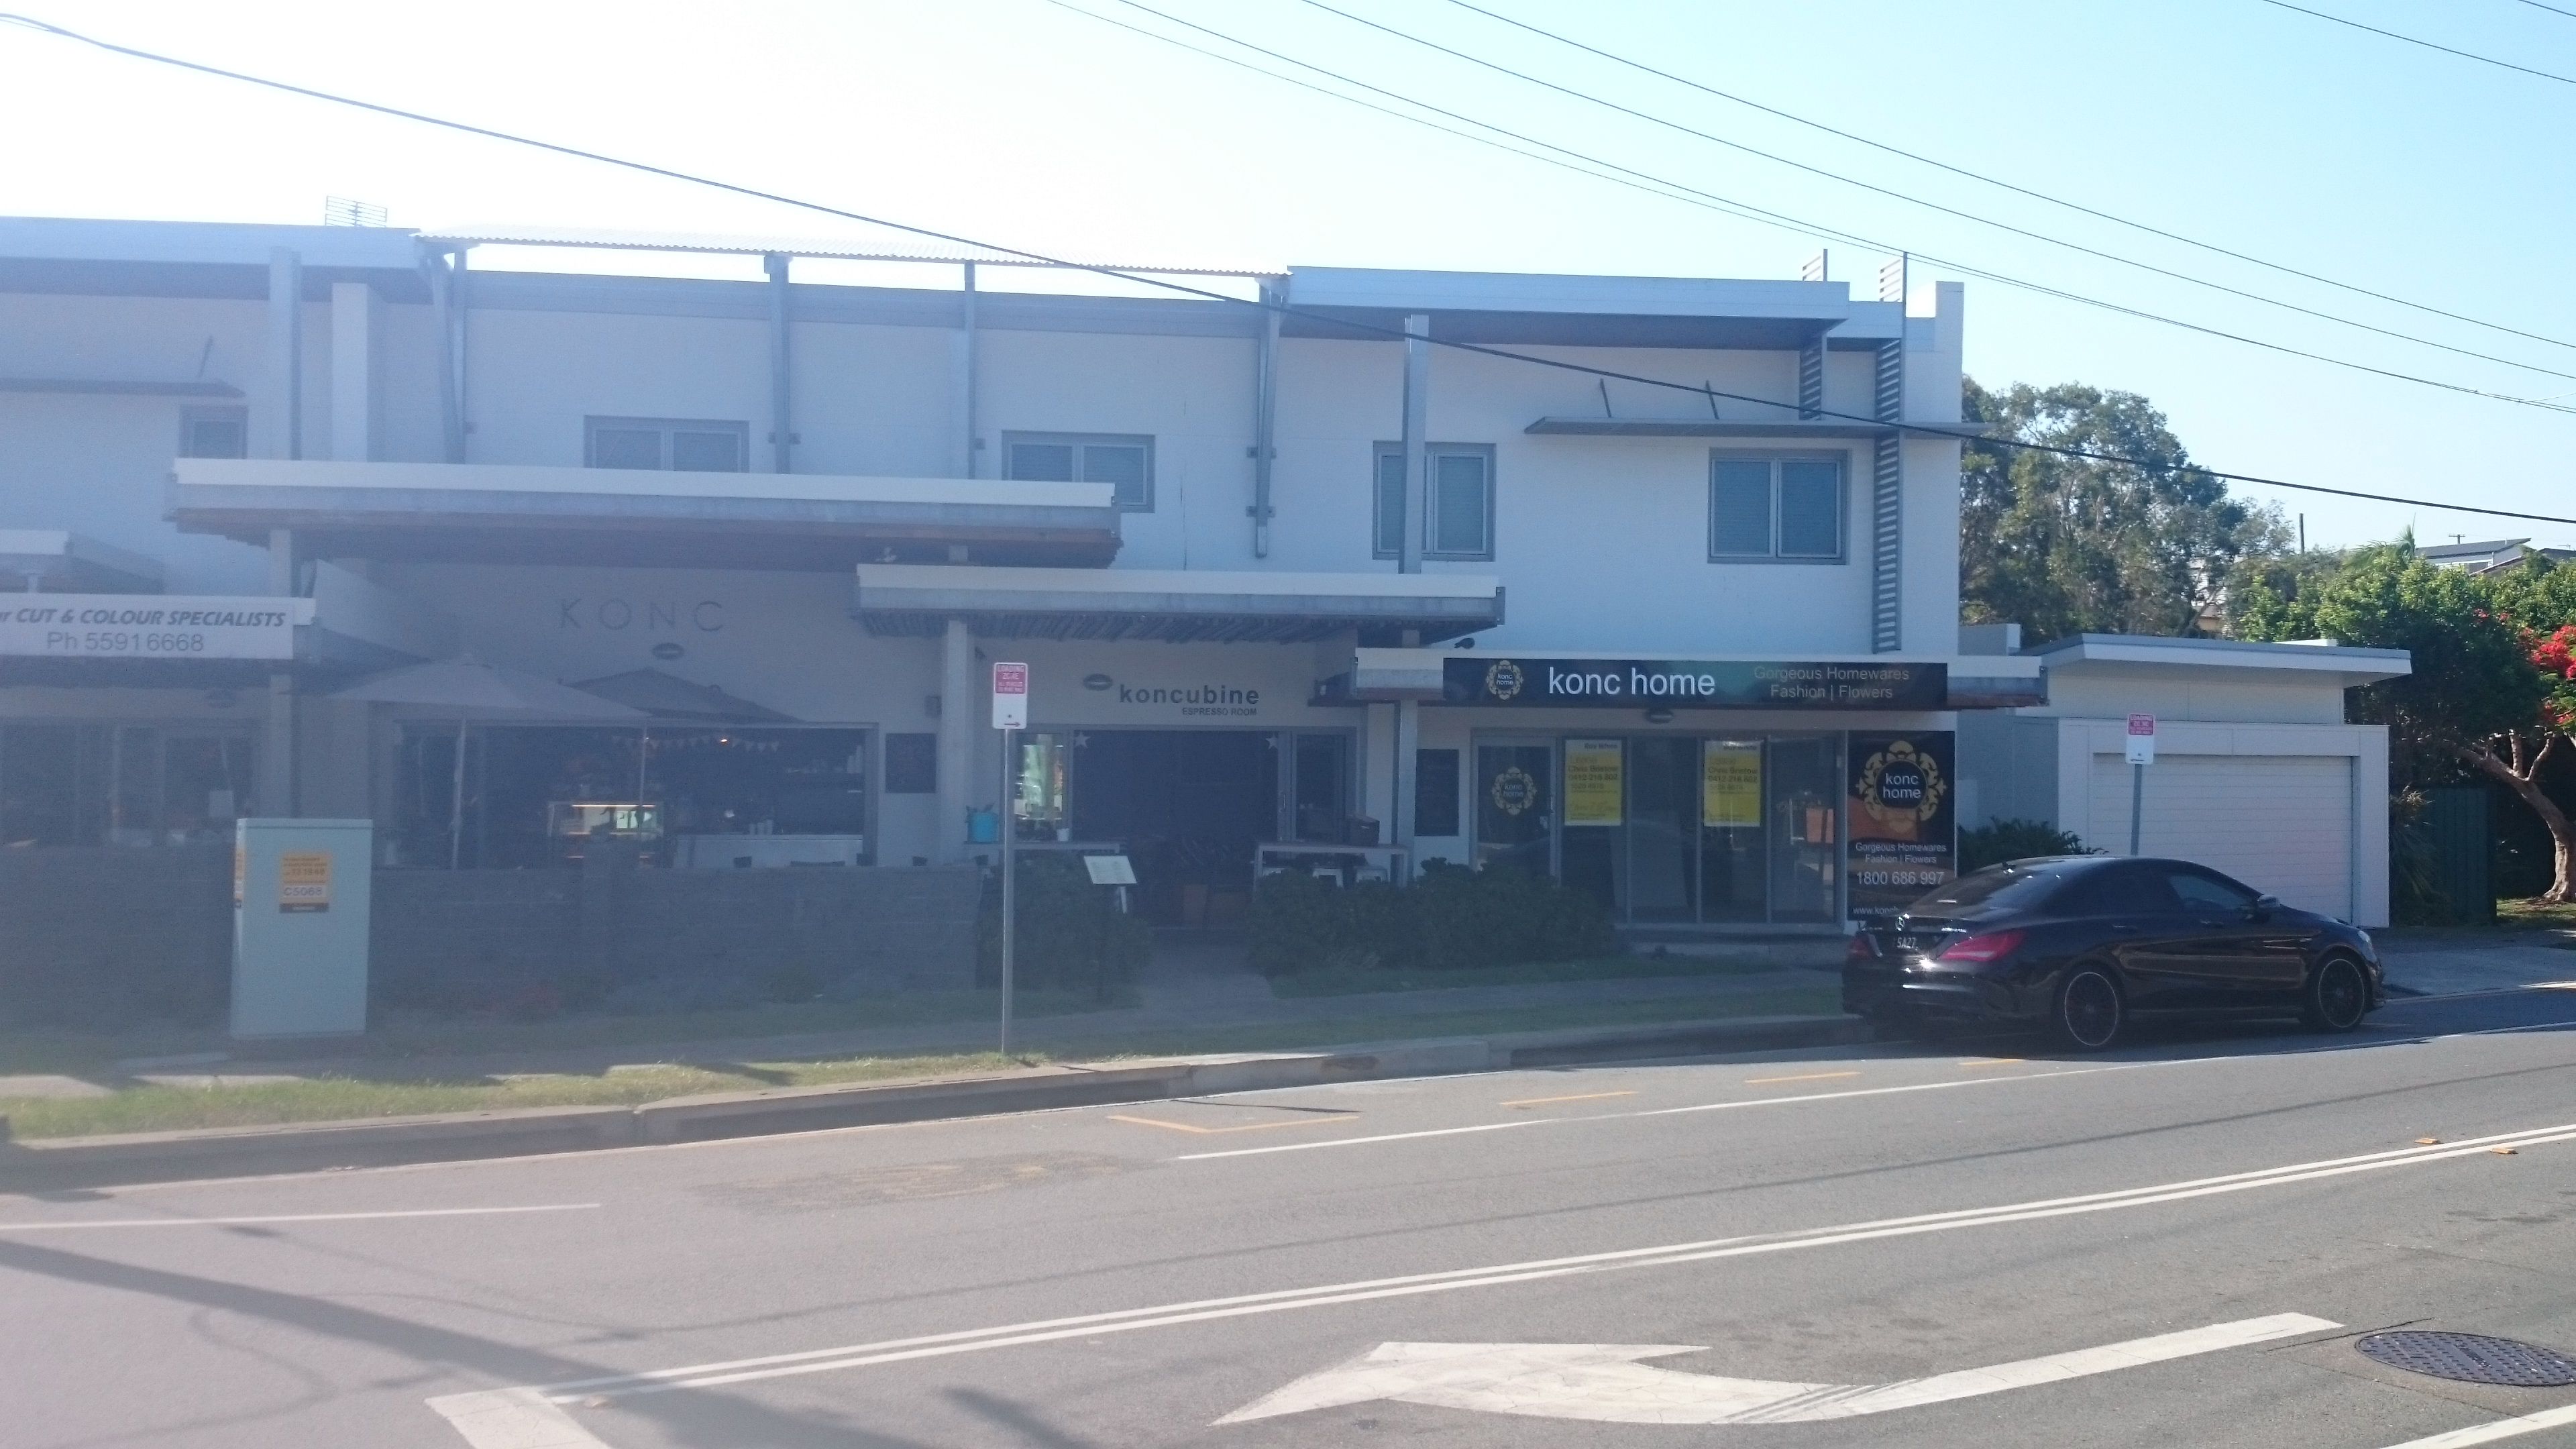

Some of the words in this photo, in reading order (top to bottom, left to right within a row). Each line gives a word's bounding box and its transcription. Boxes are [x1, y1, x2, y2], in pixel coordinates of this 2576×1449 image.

[17, 608, 58, 623] CUT
[62, 609, 74, 623] &
[80, 610, 164, 625] COLOUR
[167, 611, 287, 627] SPECIALISTS
[561, 599, 723, 631] KONC
[47, 632, 78, 649] Ph
[1549, 667, 1620, 694] konc
[1631, 667, 1715, 695] home
[1754, 666, 1821, 682] Gorgeous
[1827, 667, 1910, 680] Homewares
[1119, 684, 1259, 704] koncubine
[1770, 684, 1826, 698] Fashion
[1839, 686, 1893, 698] Flowers
[1182, 708, 1228, 716] ESPRESSO
[1231, 708, 1257, 716] ROOM
[1885, 773, 1919, 785] konc
[1883, 786, 1921, 798] home
[1856, 843, 1895, 853] Gorgeous
[1898, 843, 1946, 852] Homewares
[1865, 854, 1897, 863] Fashion
[1904, 855, 1937, 864] Flowers
[1856, 871, 1888, 885] 1800
[1891, 871, 1916, 885] 686
[1920, 871, 1945, 885] 997
